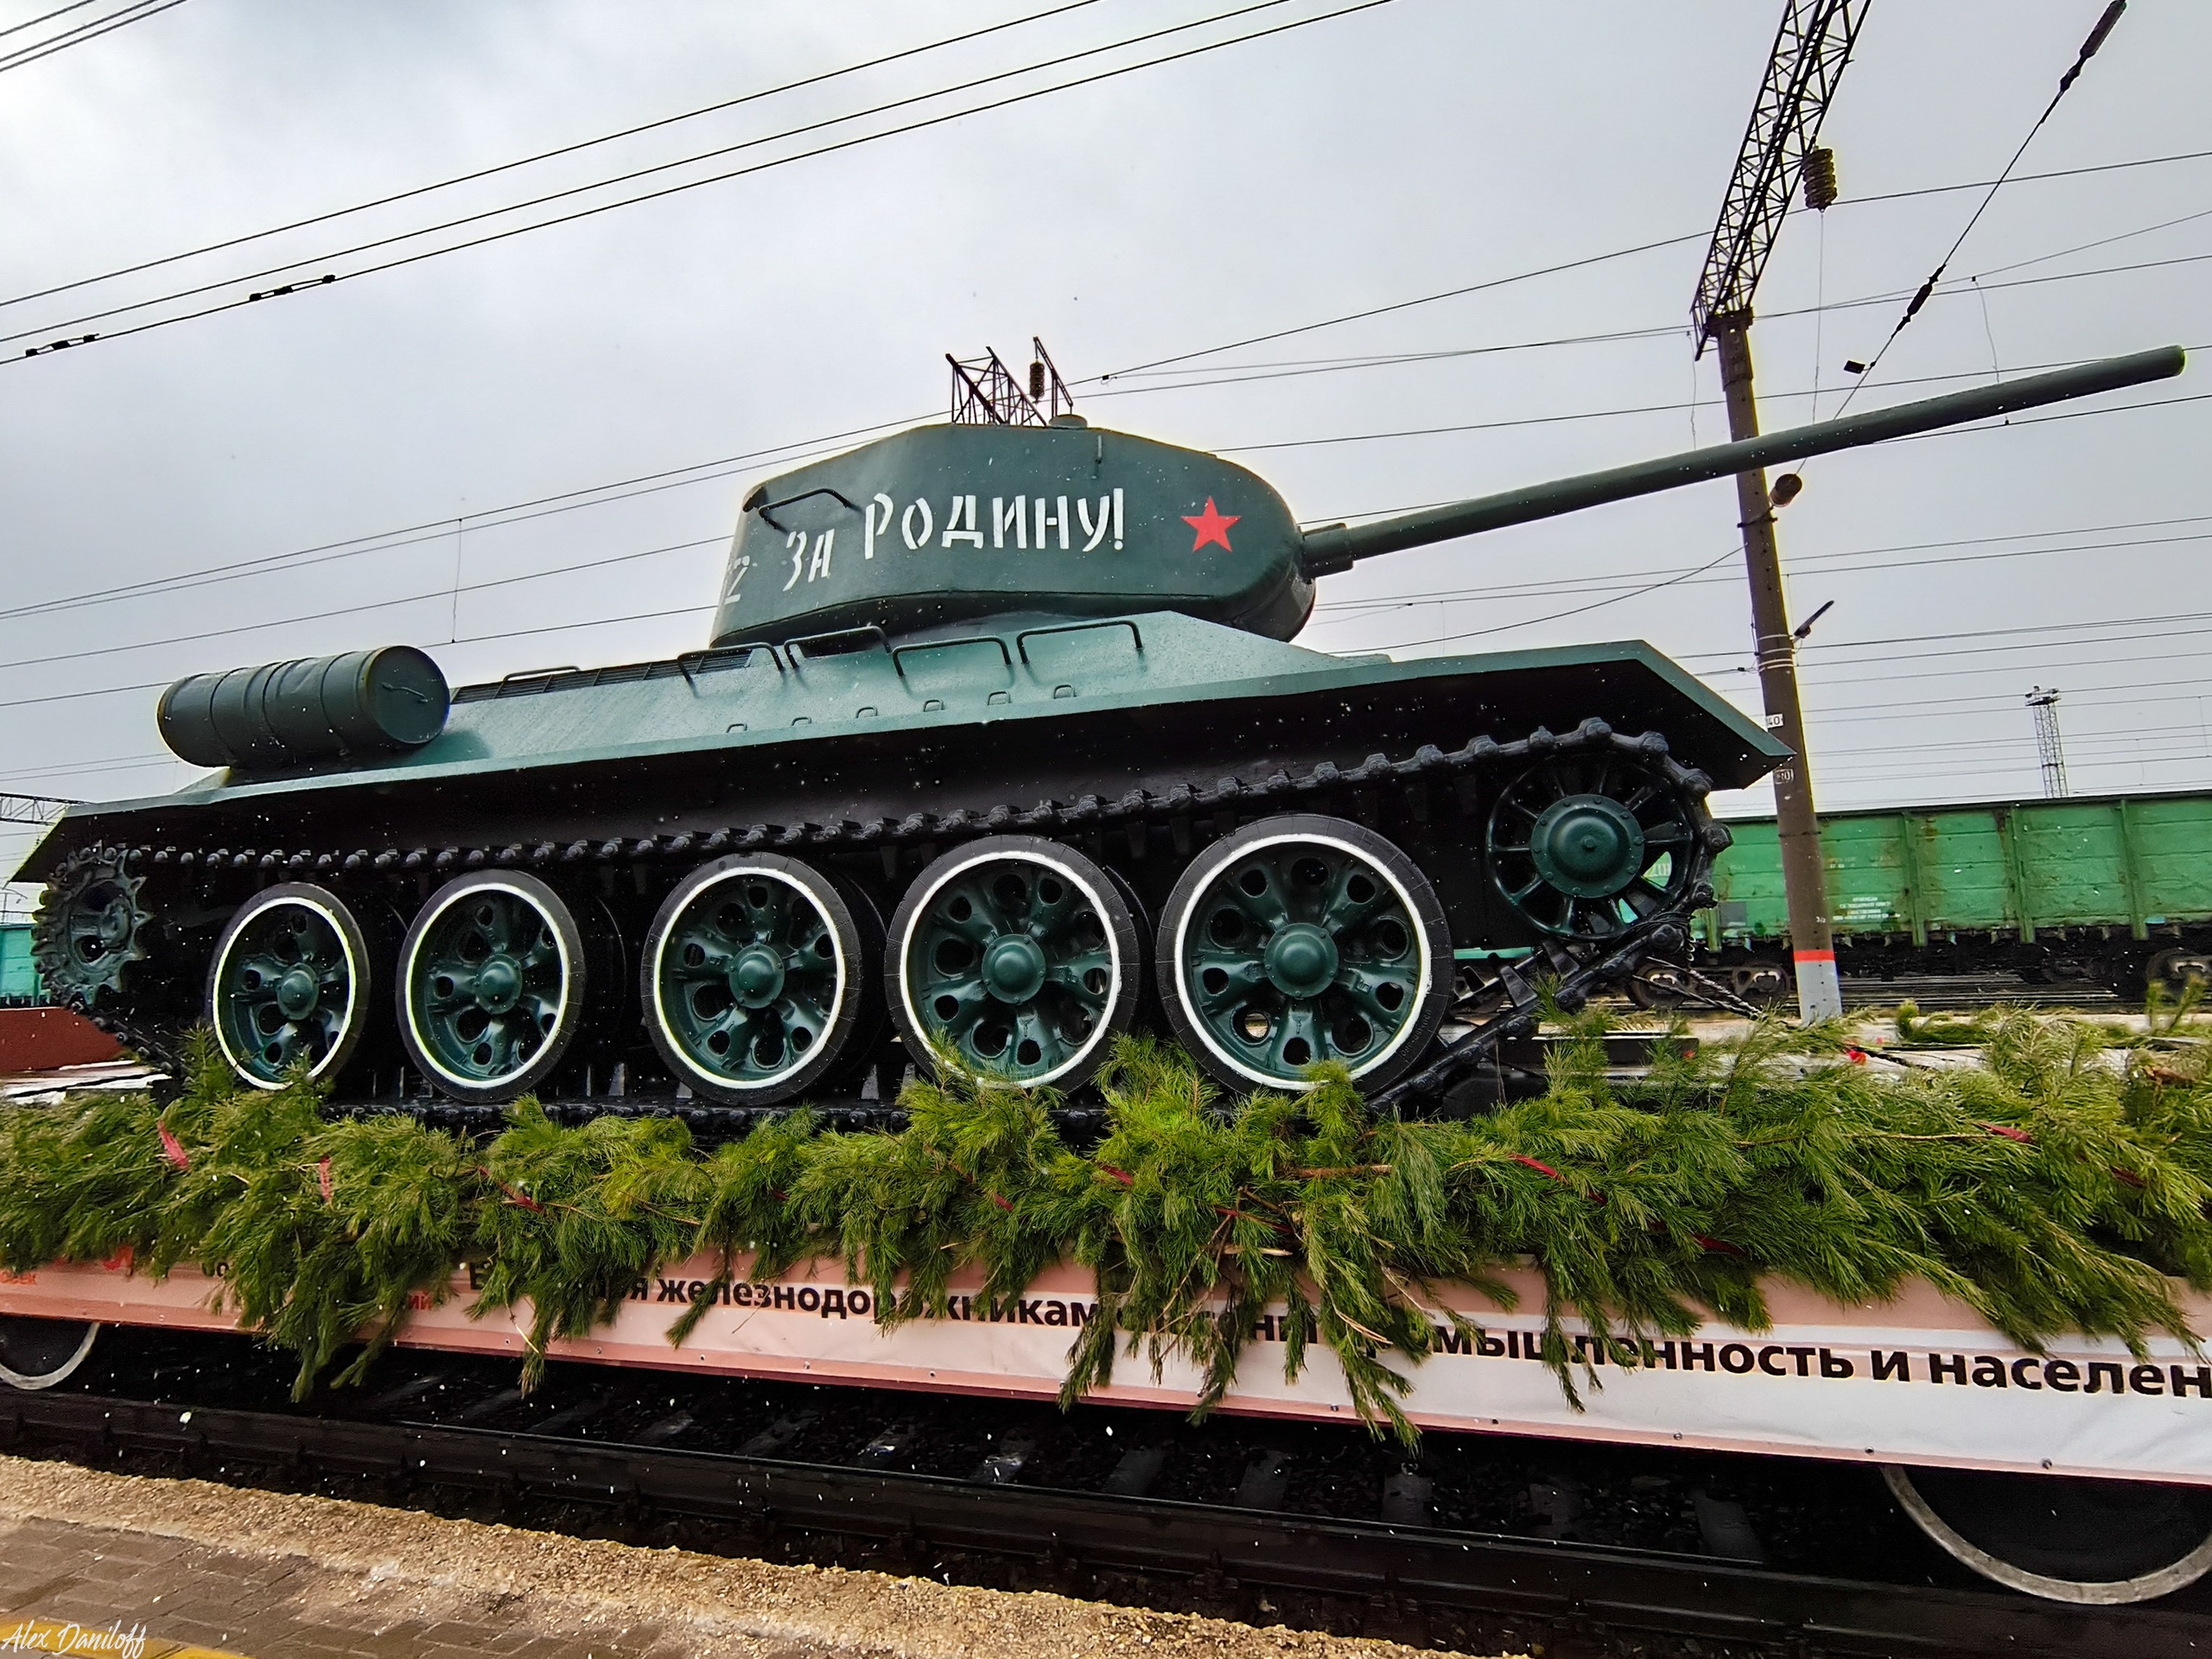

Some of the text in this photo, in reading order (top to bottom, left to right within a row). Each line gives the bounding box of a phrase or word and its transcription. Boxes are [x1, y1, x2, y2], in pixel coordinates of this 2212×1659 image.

[783, 487, 1123, 591] ЗА РОДИНУ!
[656, 1278, 1100, 1326] железнодоржникам
[1871, 1351, 1911, 1383] и
[1929, 1353, 2212, 1398] населен
